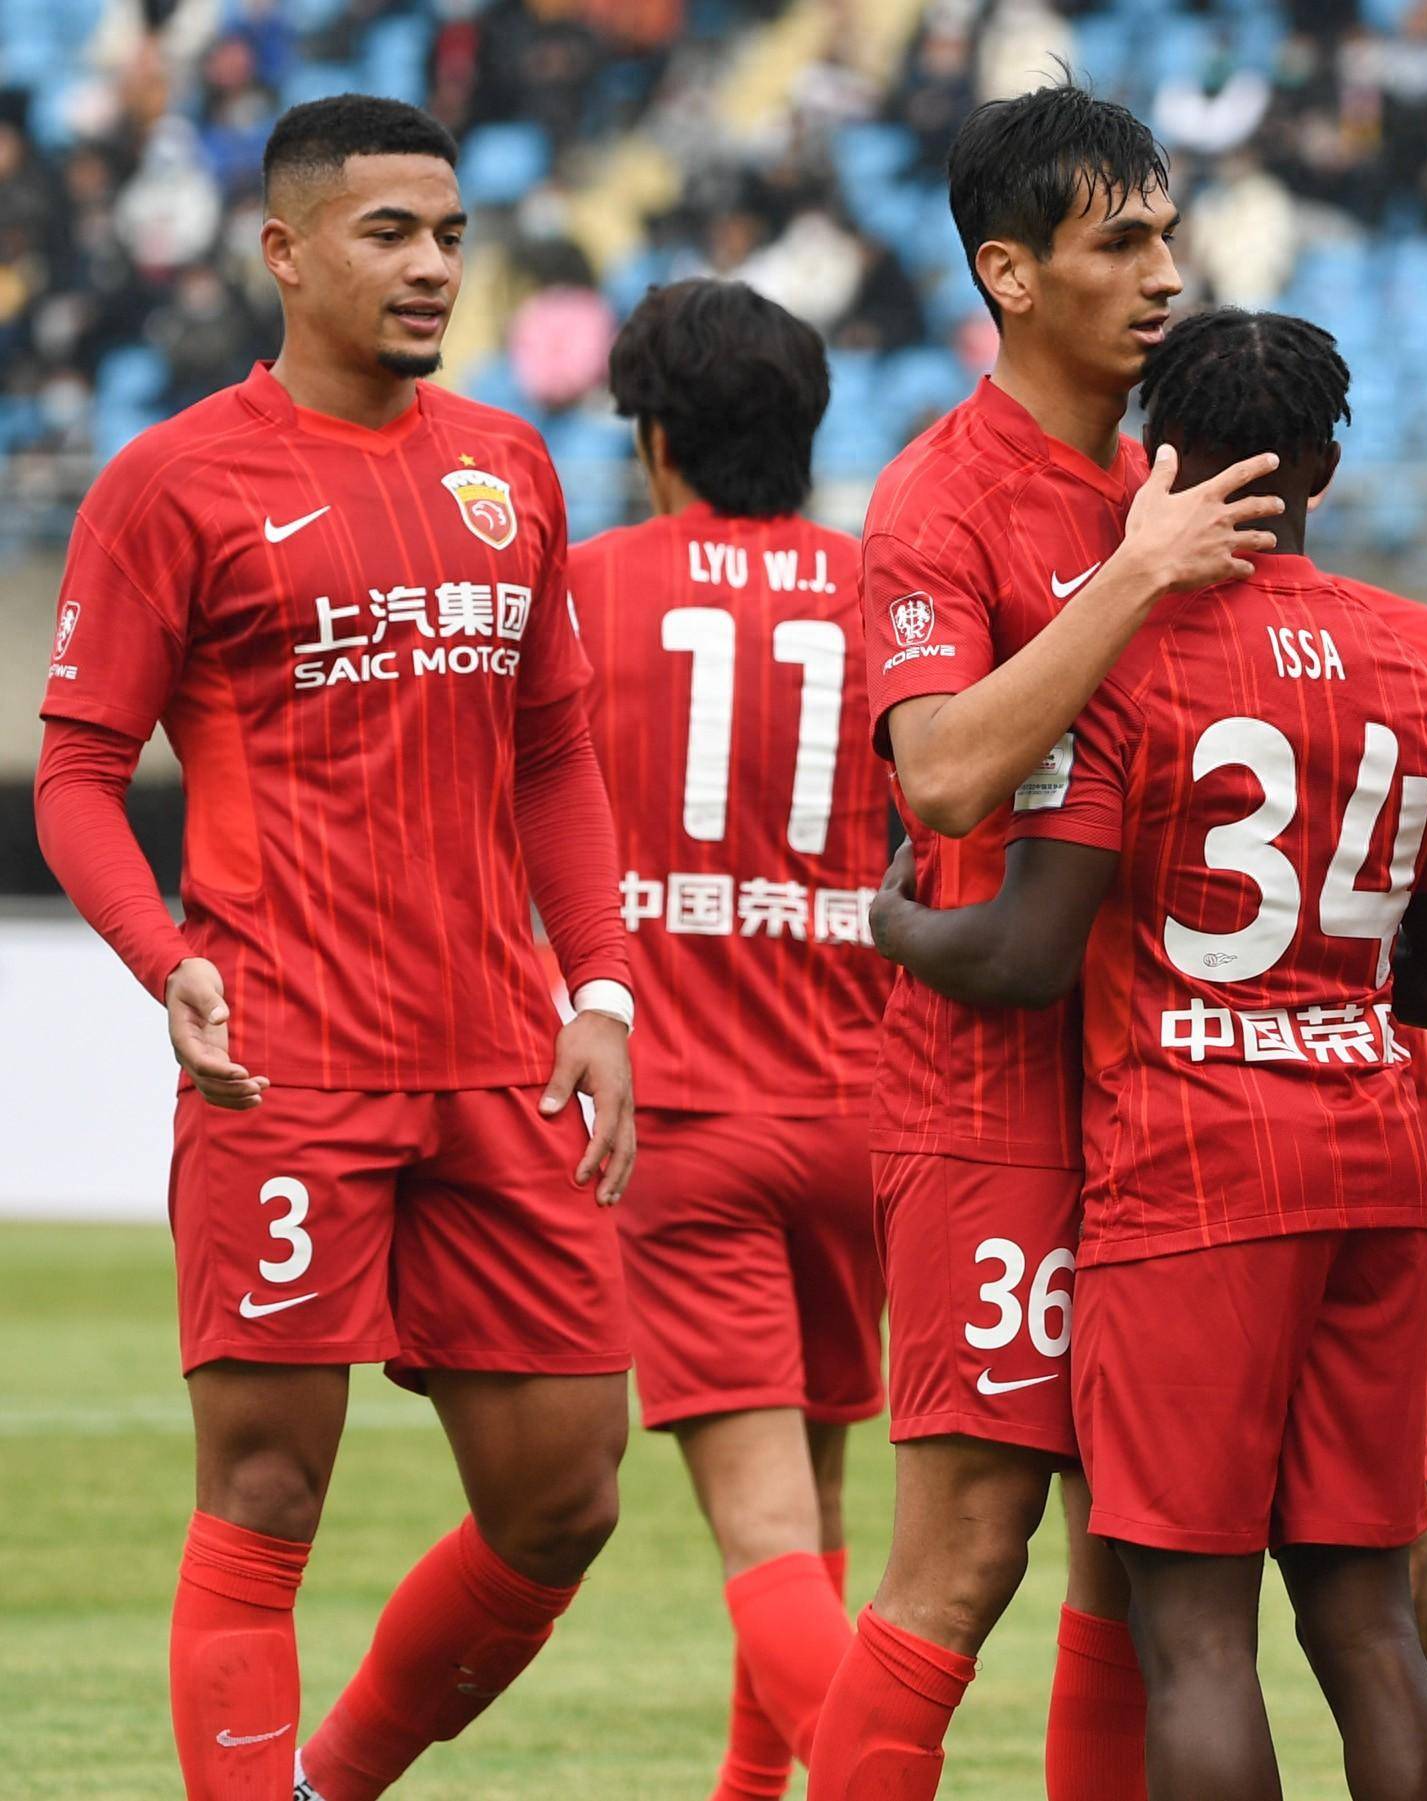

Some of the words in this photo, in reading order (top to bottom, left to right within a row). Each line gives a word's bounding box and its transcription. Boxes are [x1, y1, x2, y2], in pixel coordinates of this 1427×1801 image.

[688, 540, 749, 589] LYU
[763, 549, 837, 593] W.J.
[294, 581, 532, 654] 上汽集团
[1266, 626, 1346, 681] ISSA
[294, 655, 399, 689] SAIC
[882, 644, 956, 675] ROEWE
[661, 607, 845, 855] 11
[619, 871, 876, 947] 中国荣威
[259, 1176, 313, 1283] 3
[964, 1238, 1074, 1357] 36
